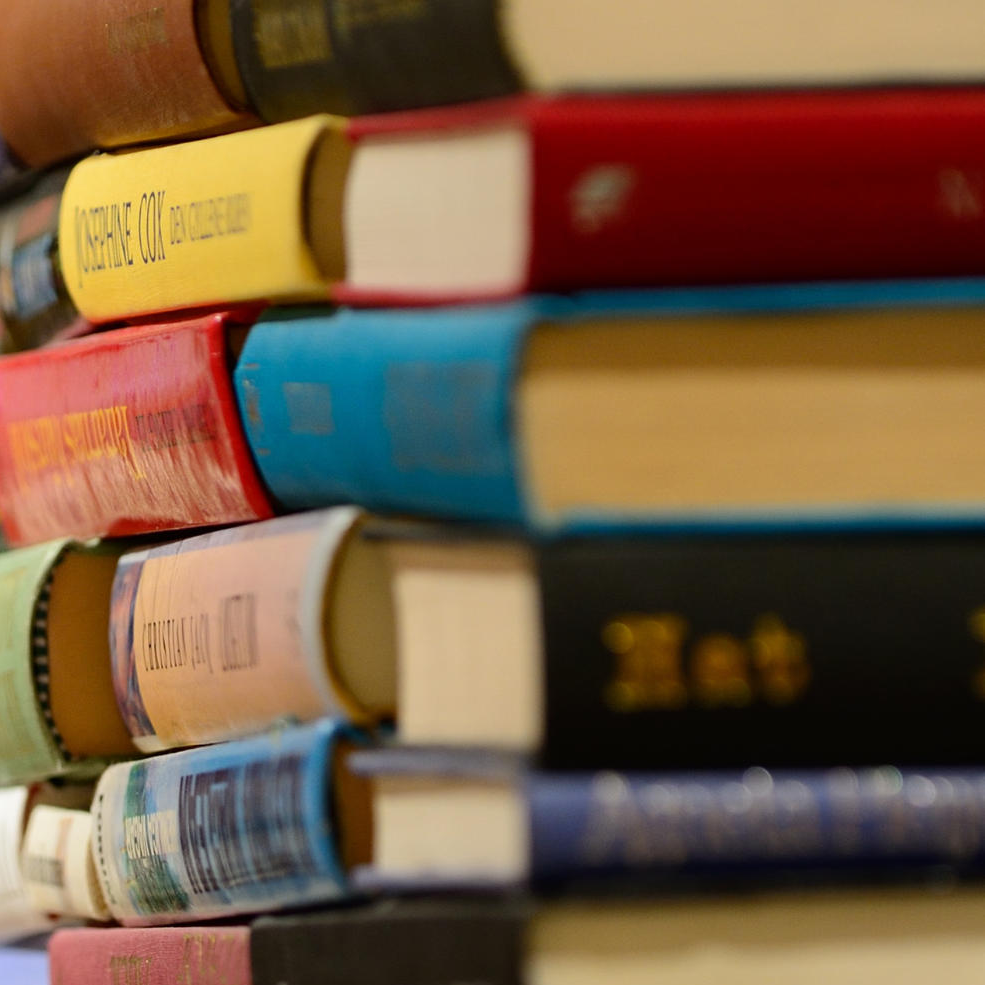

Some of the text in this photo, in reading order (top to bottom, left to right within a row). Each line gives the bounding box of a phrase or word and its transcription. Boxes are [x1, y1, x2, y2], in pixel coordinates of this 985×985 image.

[75, 201, 134, 289] JOSEPHINE
[138, 190, 166, 265] COX
[169, 204, 188, 245] DEN
[142, 616, 187, 672] CHRISTIAN
